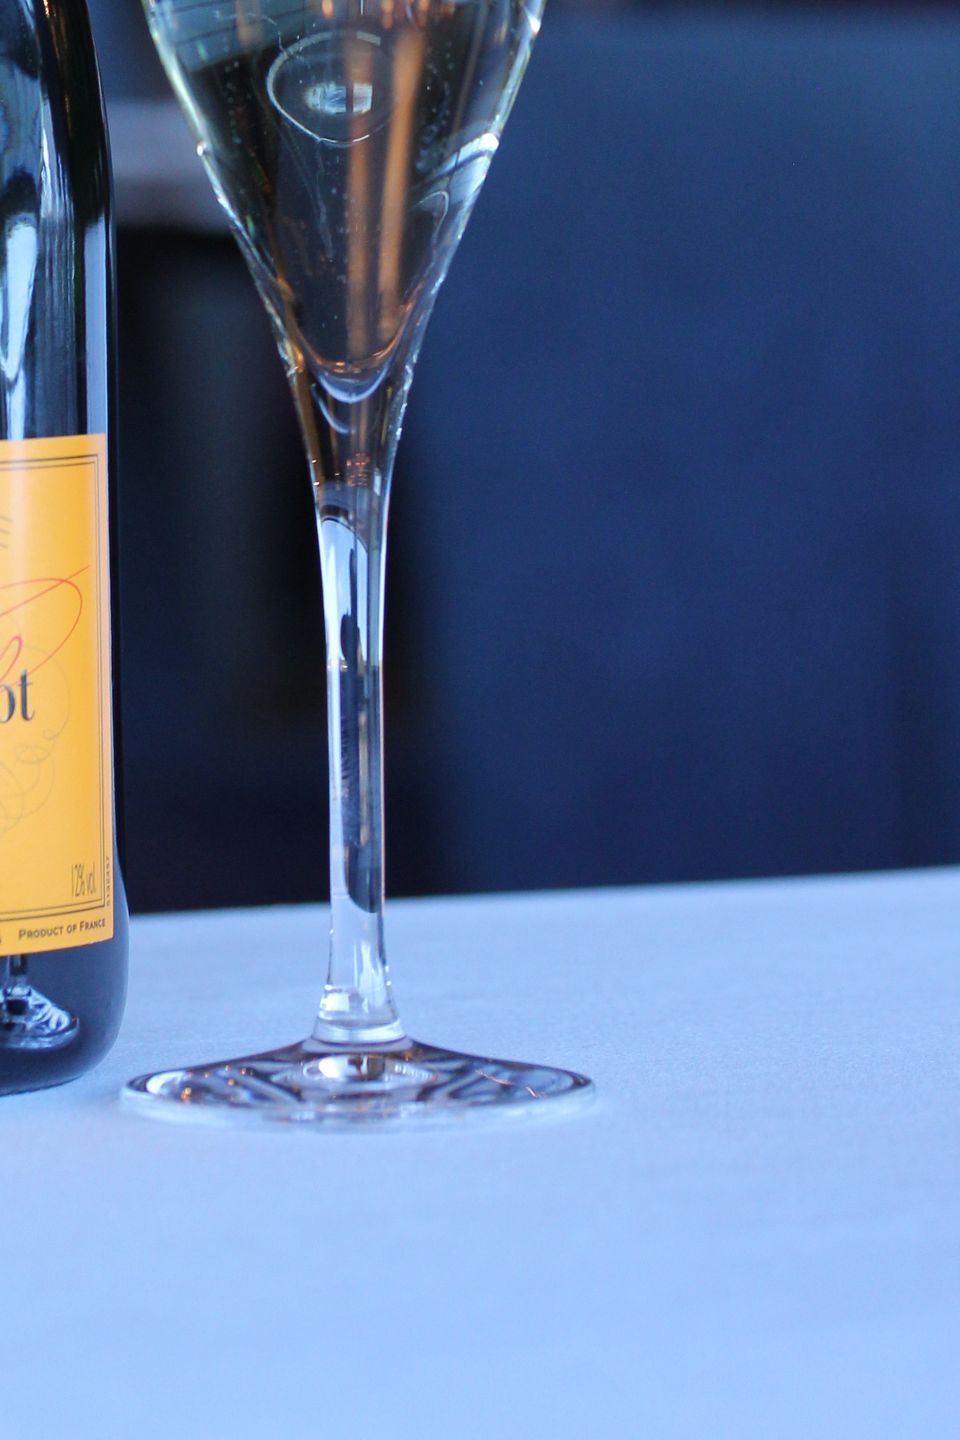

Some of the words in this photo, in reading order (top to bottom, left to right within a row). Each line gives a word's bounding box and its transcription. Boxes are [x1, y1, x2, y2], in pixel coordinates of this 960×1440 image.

[18, 925, 65, 941] PRODUCT
[66, 923, 79, 934] OF
[79, 918, 107, 932] FRANCE
